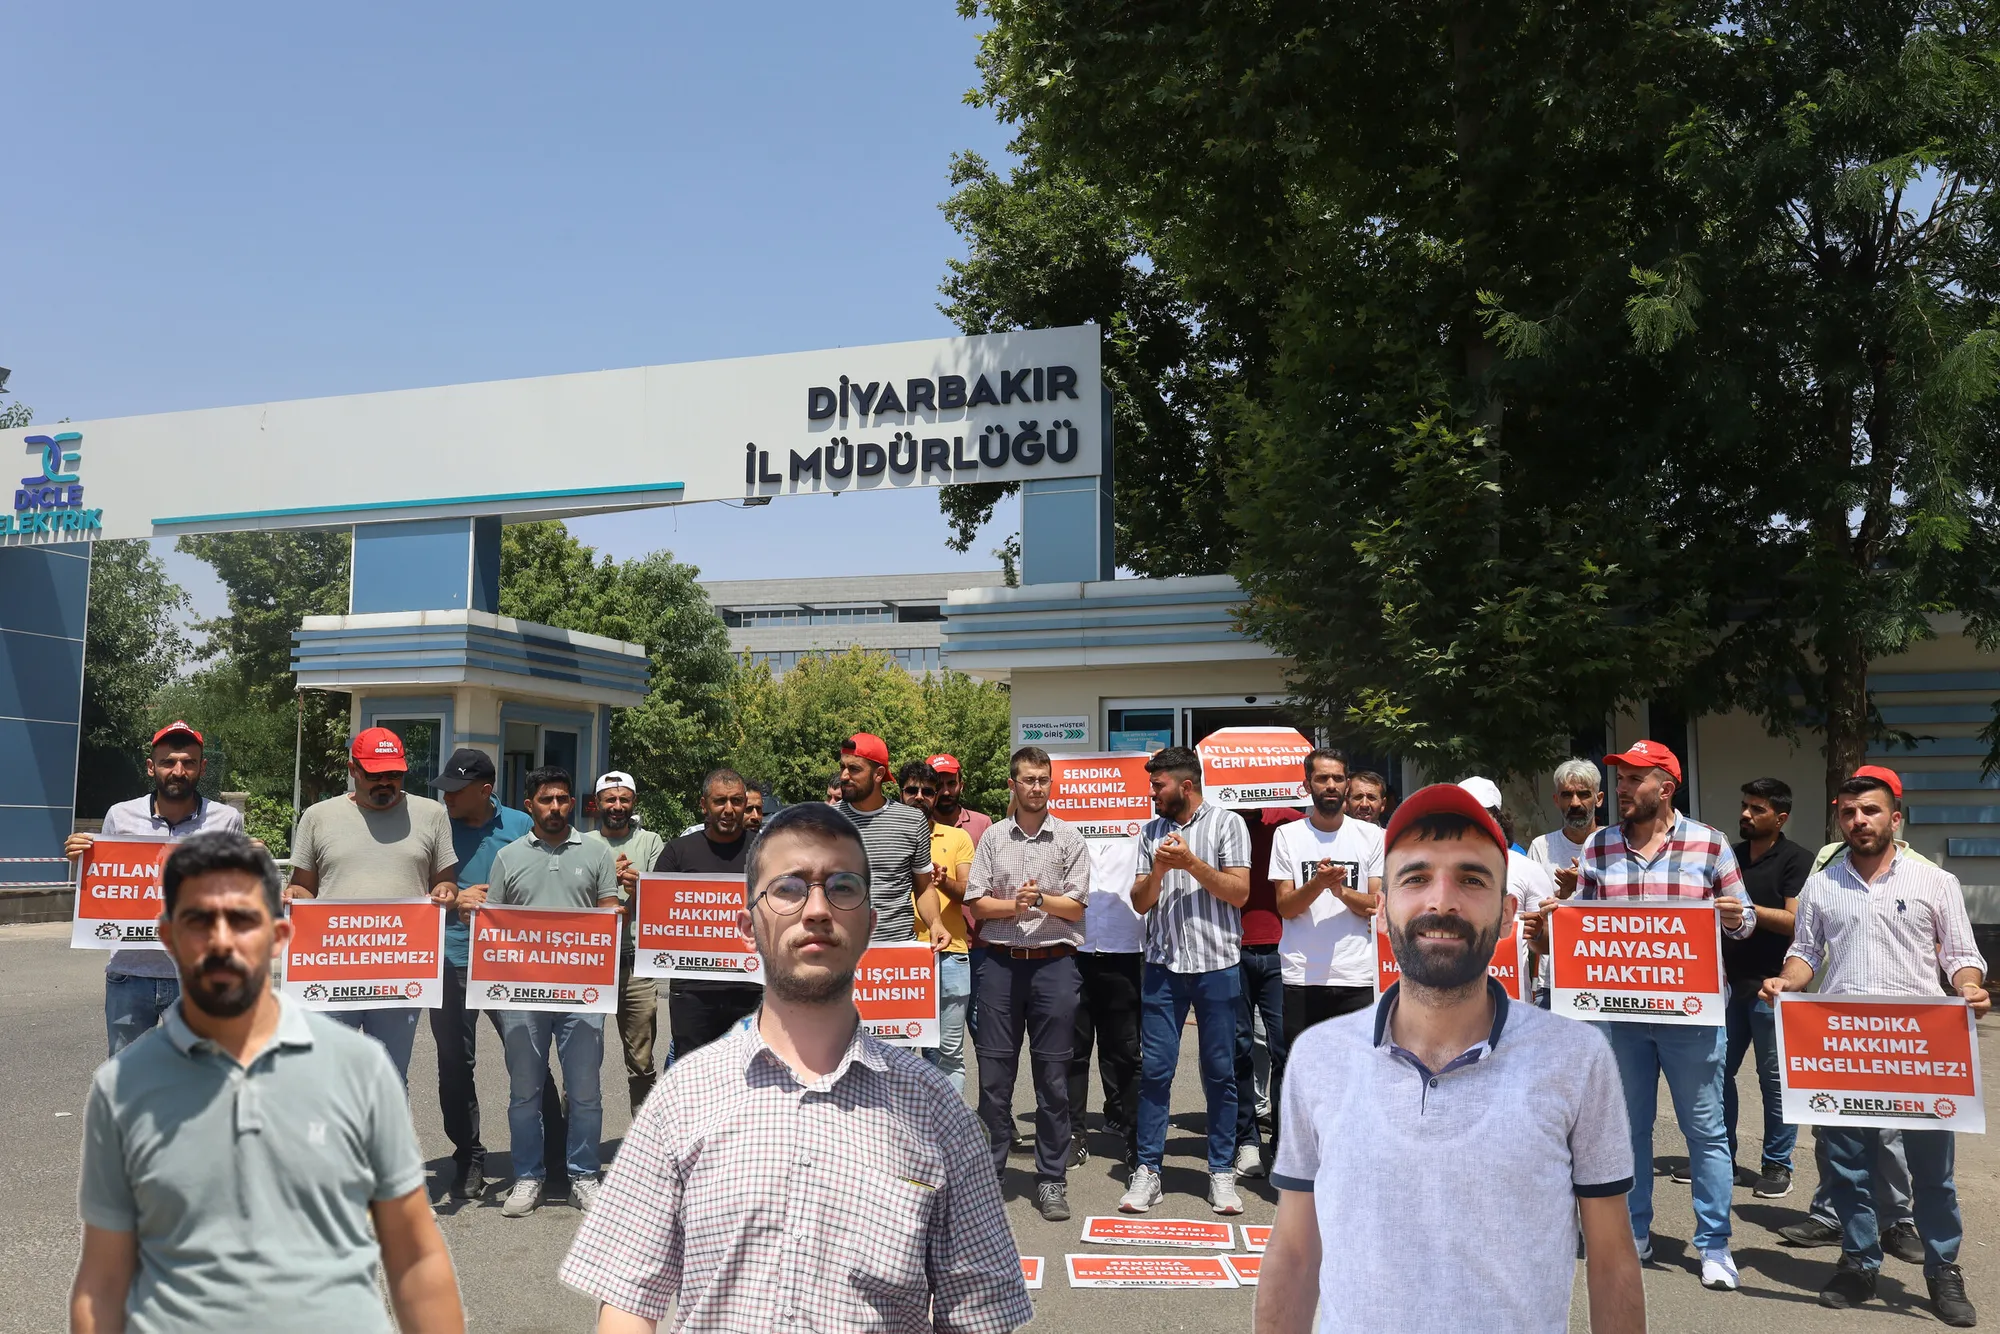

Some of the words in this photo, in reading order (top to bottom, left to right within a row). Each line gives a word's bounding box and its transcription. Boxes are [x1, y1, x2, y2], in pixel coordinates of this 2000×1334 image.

[808, 365, 1079, 420] DİYARBAKIR
[746, 442, 782, 484] İL
[789, 418, 1078, 482] MÜDÜRLÜĞÜ
[14, 485, 84, 510] DİCLE
[0, 508, 103, 535] ELEKTRİK
[1059, 721, 1086, 729] MÜŞTERİ
[1044, 730, 1063, 738] GİRİŞ
[1204, 745, 1254, 754] ATILAN
[1248, 755, 1305, 768] ALINSIN
[1063, 767, 1121, 780] SENDİKA
[1059, 782, 1126, 795] HAKKIMIZ
[1047, 796, 1148, 810] NGELLENEMEZ!
[1077, 825, 1121, 834] NERJİSEN
[86, 862, 160, 878] ATILAN
[91, 884, 139, 899] GERİ
[674, 891, 742, 905] SENDİKA
[328, 915, 403, 929] SENDİKA
[669, 908, 742, 922] HAKKIMI
[1581, 915, 1686, 935] SENDİKA
[322, 933, 407, 947] HAKKIMIZ
[478, 928, 541, 943] ATILAN
[546, 931, 612, 948] İŞÇİLER
[1573, 939, 1698, 960] ANAYASAL
[291, 951, 434, 966] ENGELLENEMEZ!
[483, 949, 524, 963] GERİ
[528, 950, 605, 966] ALINSIN!
[867, 966, 931, 984] İŞÇİLER
[1586, 964, 1684, 985] HAKTIR!
[852, 986, 925, 1001] ALINSIN!
[1827, 1016, 1921, 1032] SENDİKA
[1823, 1036, 1929, 1055] HAKKIMIZ
[1790, 1056, 1967, 1077] ENGELLENEMEZ!
[1127, 1229, 1225, 1238] KAVGASINDA!
